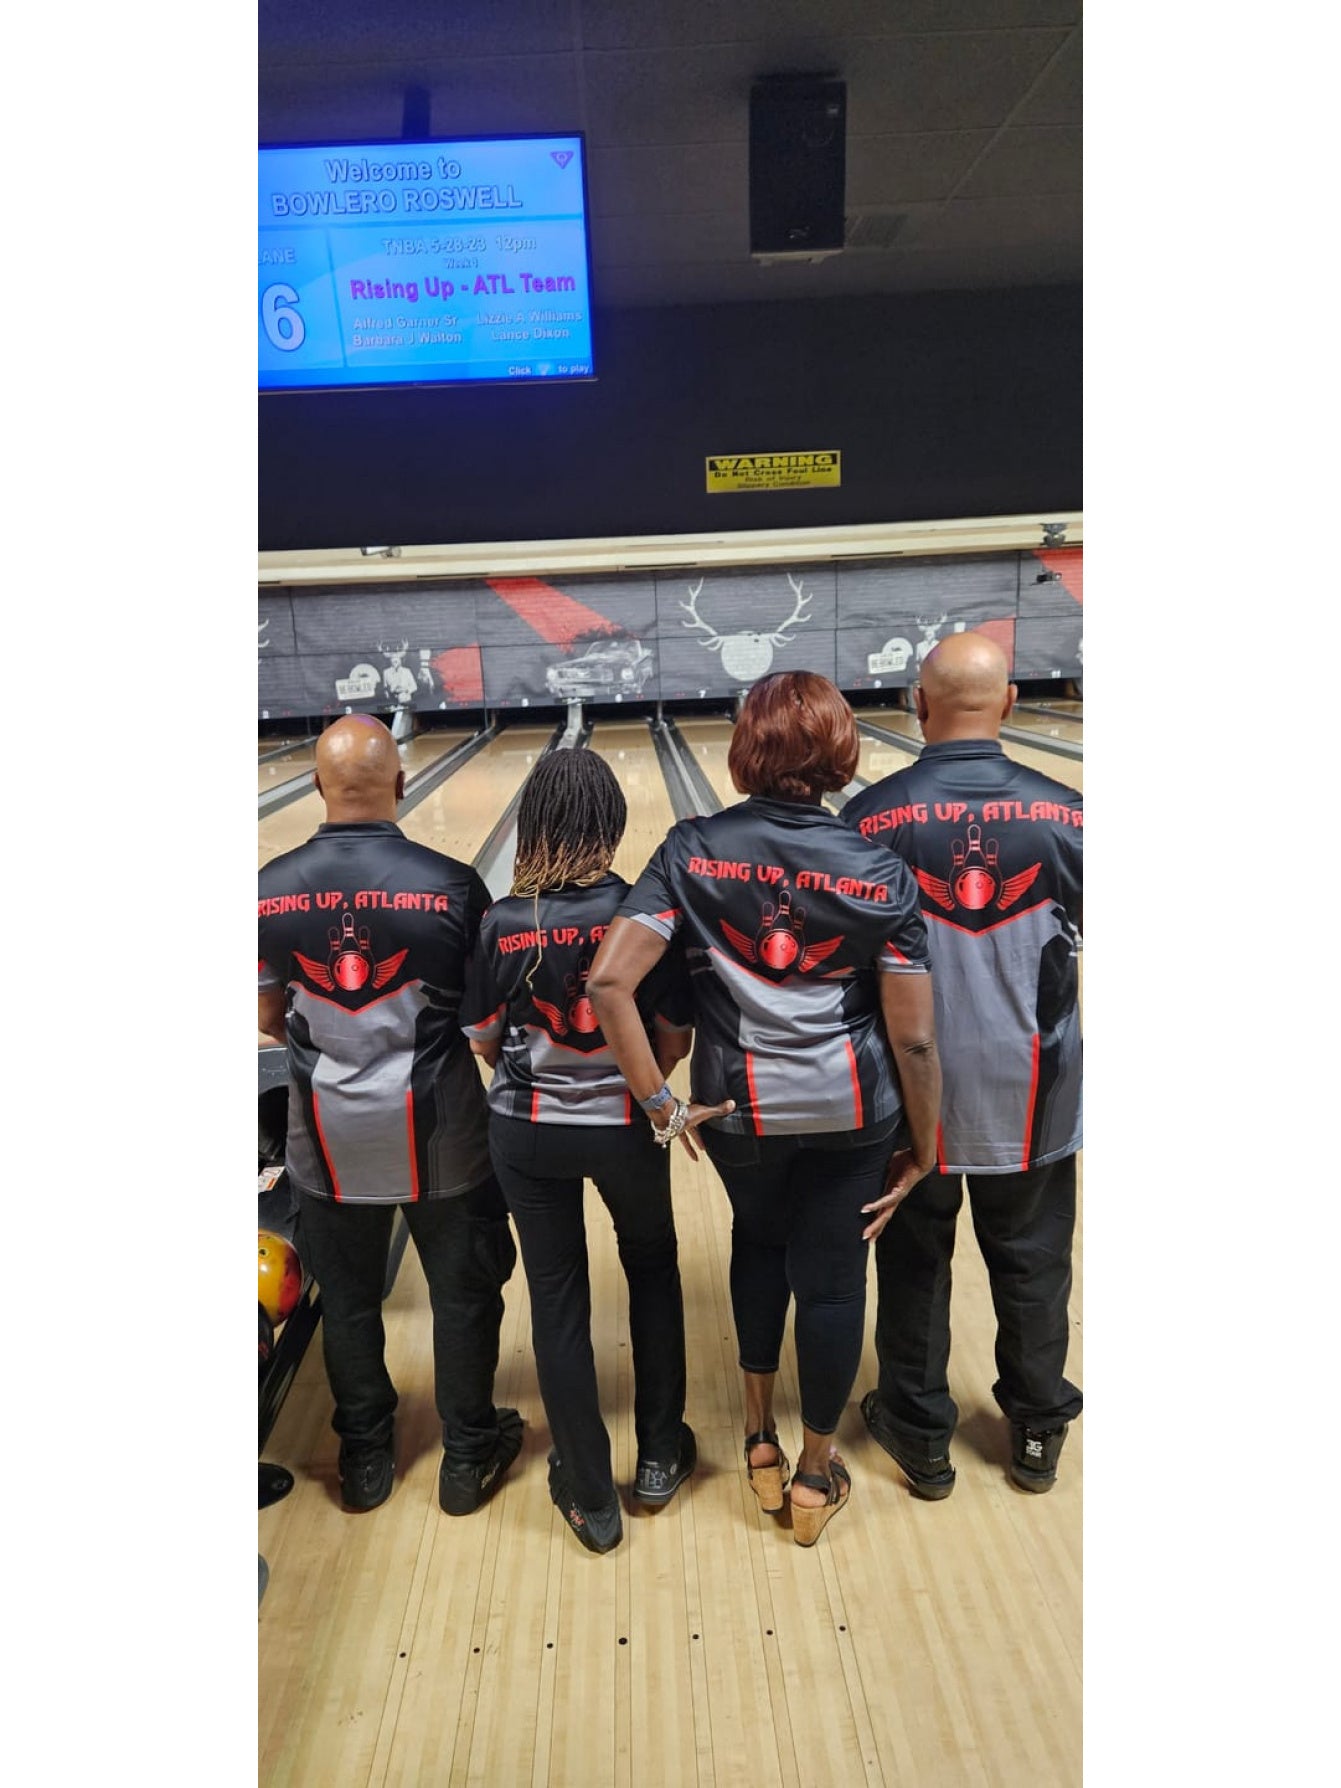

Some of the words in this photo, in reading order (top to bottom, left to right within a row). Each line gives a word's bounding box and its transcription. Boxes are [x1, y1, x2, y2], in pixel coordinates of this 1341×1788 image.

[323, 157, 432, 183] Welcome
[437, 156, 461, 179] to
[271, 189, 398, 216] BOWLERO
[402, 184, 523, 212] ROSWELL
[382, 239, 428, 255] TNBA
[496, 235, 537, 253] 12pm
[350, 278, 419, 303] Rising
[424, 275, 455, 301] Up
[473, 273, 515, 296] ATL
[519, 272, 576, 294] Team
[261, 282, 306, 352] 6
[352, 333, 404, 348] Barbara
[508, 364, 532, 376] Click
[558, 364, 568, 374] to
[570, 363, 590, 376] play
[714, 454, 833, 470] WARNING
[714, 470, 727, 478] Do
[732, 469, 748, 477] Not
[859, 803, 928, 836] RISING
[934, 802, 975, 824] UP,
[982, 801, 1083, 828] ATLANTA
[687, 857, 751, 883] RISING
[756, 864, 789, 888] UP,
[796, 870, 888, 903] ATLANTA
[258, 893, 310, 918] RISING
[315, 891, 349, 911] UP,
[354, 890, 449, 913] ATLANTA
[498, 929, 548, 955] RISING
[552, 926, 584, 946] UP,
